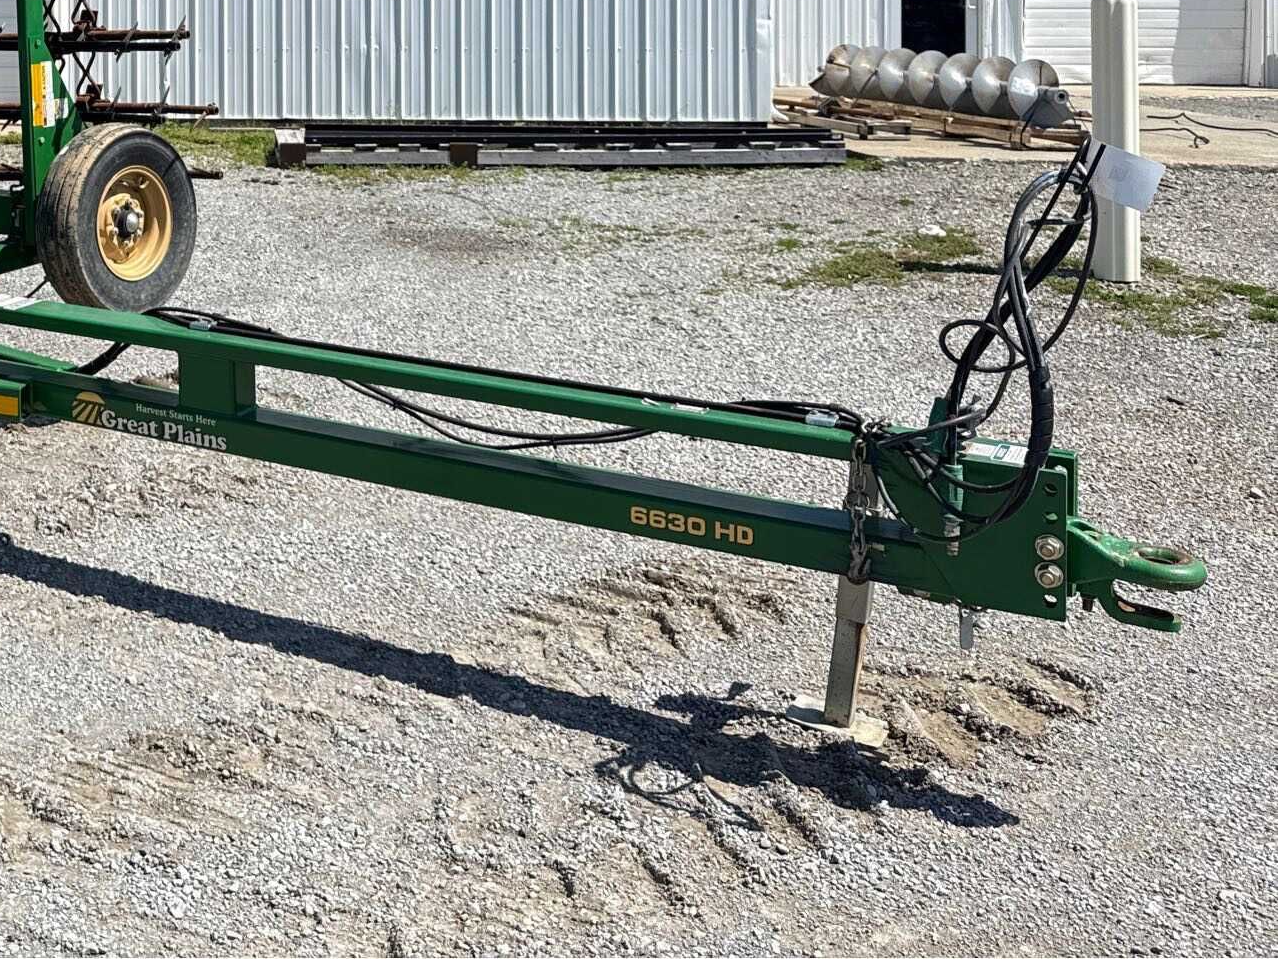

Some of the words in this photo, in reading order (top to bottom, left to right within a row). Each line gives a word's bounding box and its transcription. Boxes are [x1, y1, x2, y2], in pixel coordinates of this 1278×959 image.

[101, 409, 159, 438] Great
[163, 420, 227, 451] Plains
[135, 402, 167, 417] Harvest
[169, 409, 194, 423] Starts
[195, 414, 217, 427] Here
[630, 506, 706, 536] 6630
[714, 520, 754, 546] HD
